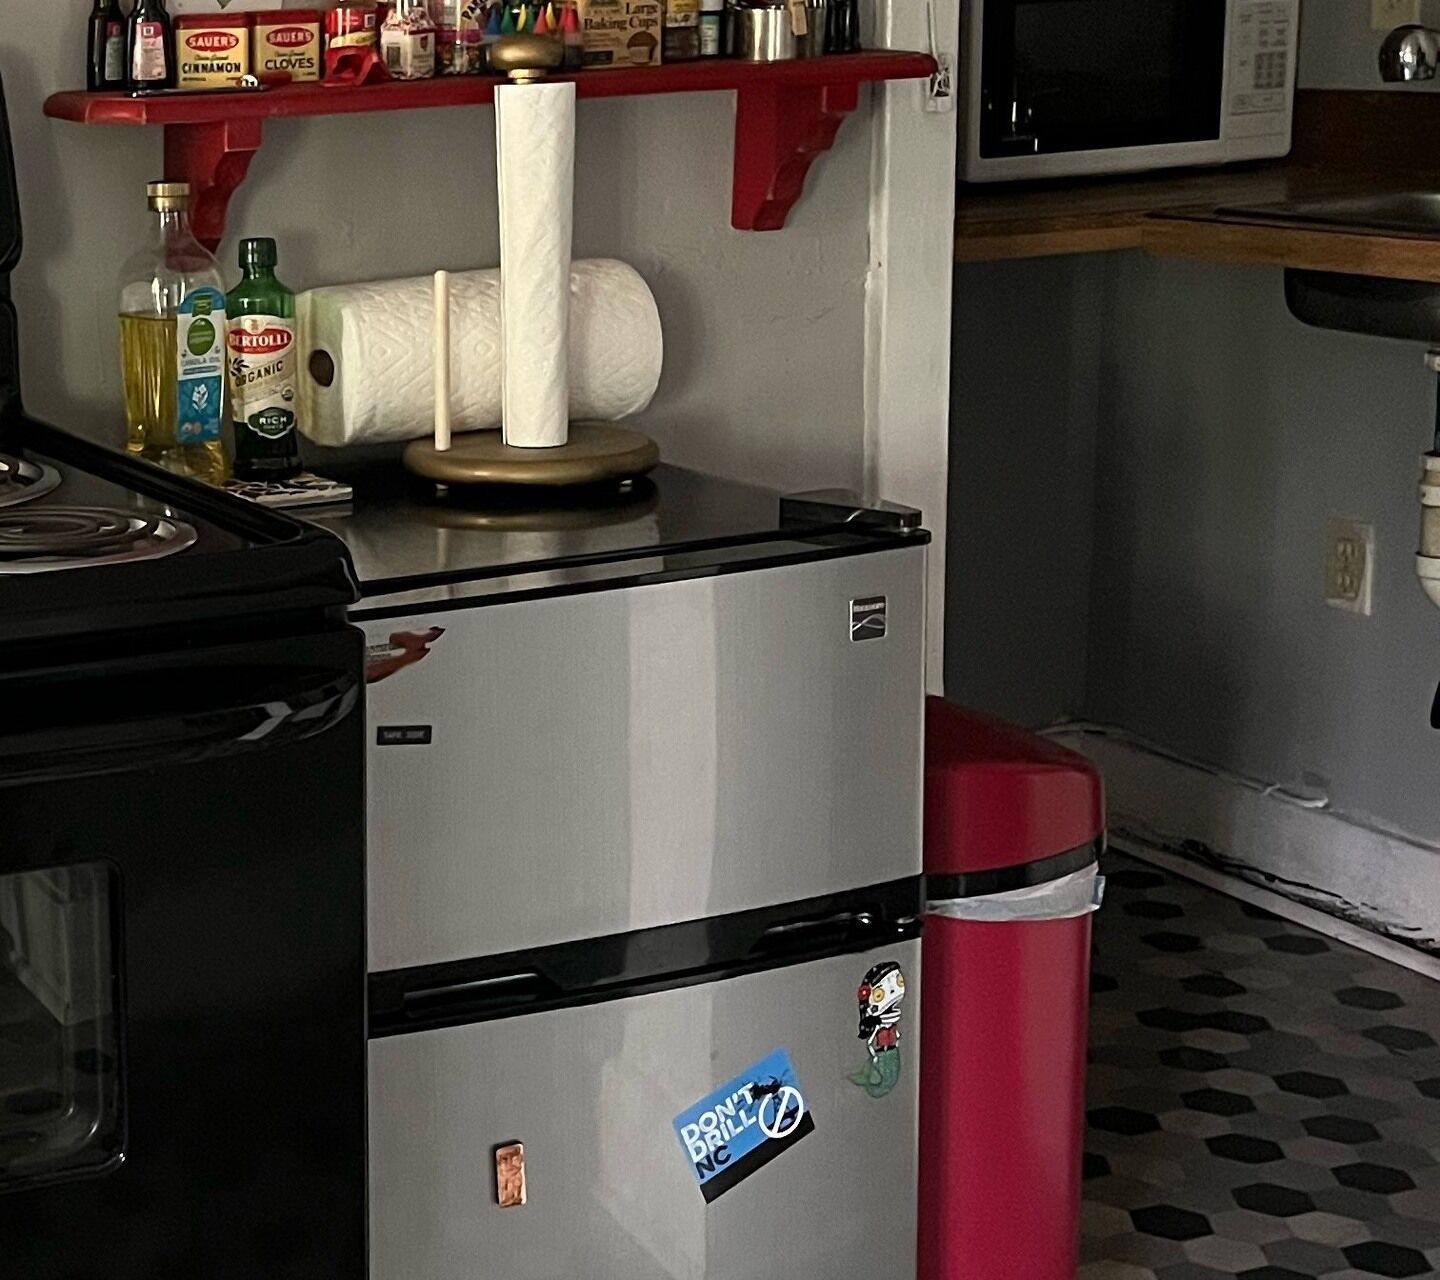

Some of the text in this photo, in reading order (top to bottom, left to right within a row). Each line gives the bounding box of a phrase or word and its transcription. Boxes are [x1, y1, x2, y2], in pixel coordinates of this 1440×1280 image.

[629, 15, 659, 30] Cups
[181, 61, 242, 75] CINNAMON
[264, 56, 315, 70] CLOVES
[229, 333, 288, 348] BERTOLLI
[235, 360, 285, 388] ORGANIC
[259, 416, 287, 425] RICH
[680, 1081, 755, 1142] DON'T
[685, 1107, 758, 1164] DRILL
[695, 1144, 733, 1180] NC
